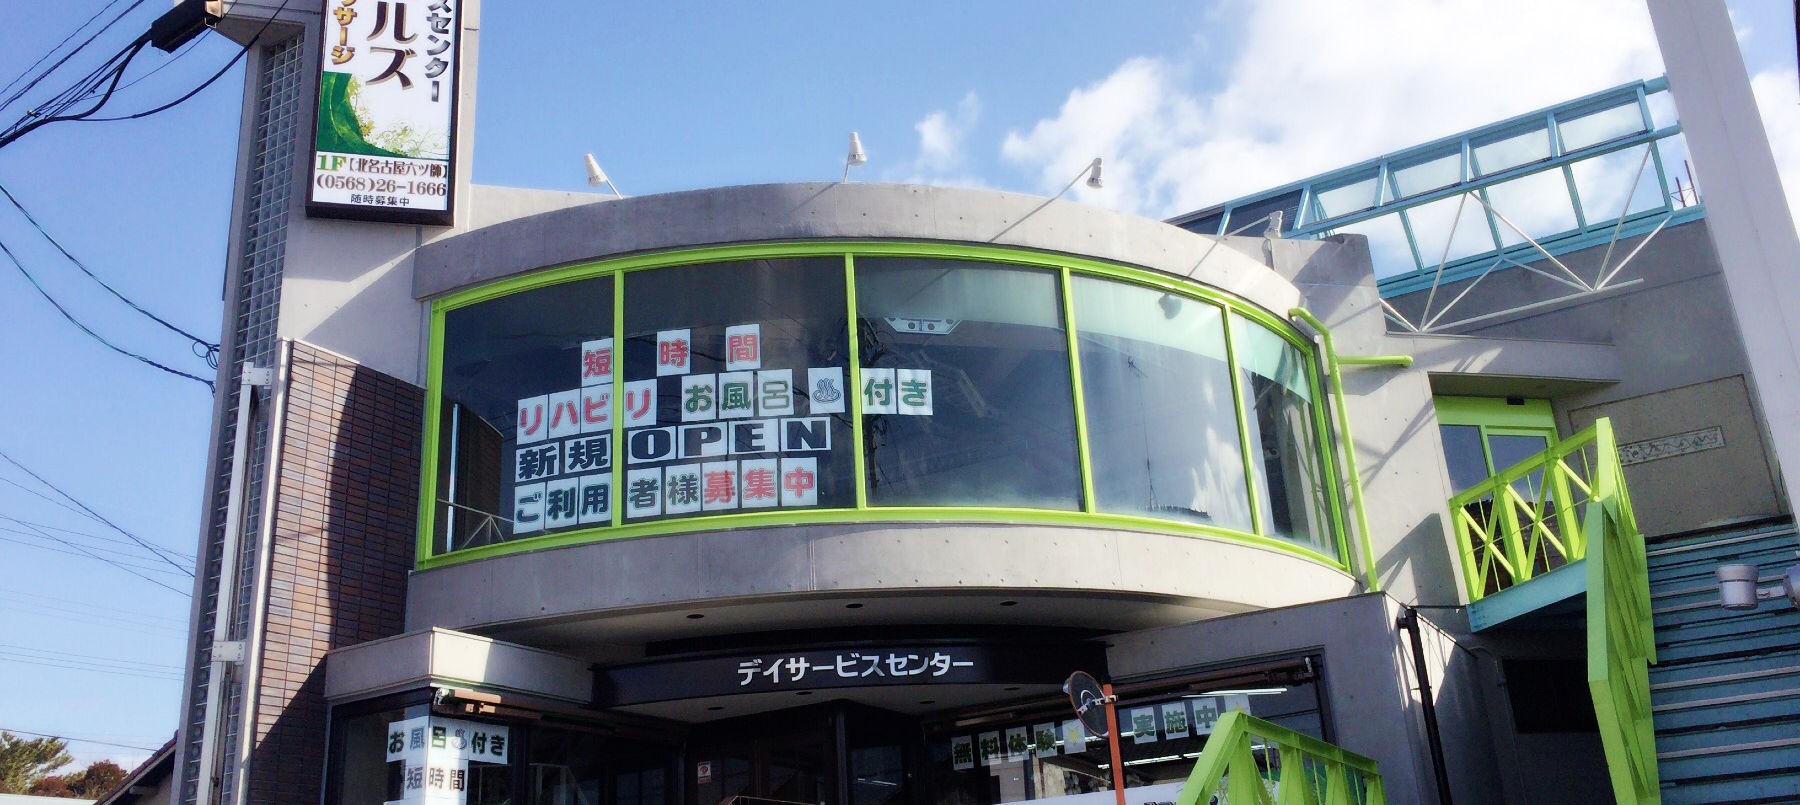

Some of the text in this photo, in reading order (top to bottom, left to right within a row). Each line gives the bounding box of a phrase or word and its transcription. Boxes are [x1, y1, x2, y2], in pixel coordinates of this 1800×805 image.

[316, 154, 347, 172] 1F
[316, 173, 447, 197] (0568)26-1666
[350, 193, 410, 206] 随時募集中
[518, 420, 827, 479] 新規 OPEN
[737, 652, 974, 686] デイサービスセンター
[406, 766, 466, 792] 短時間
